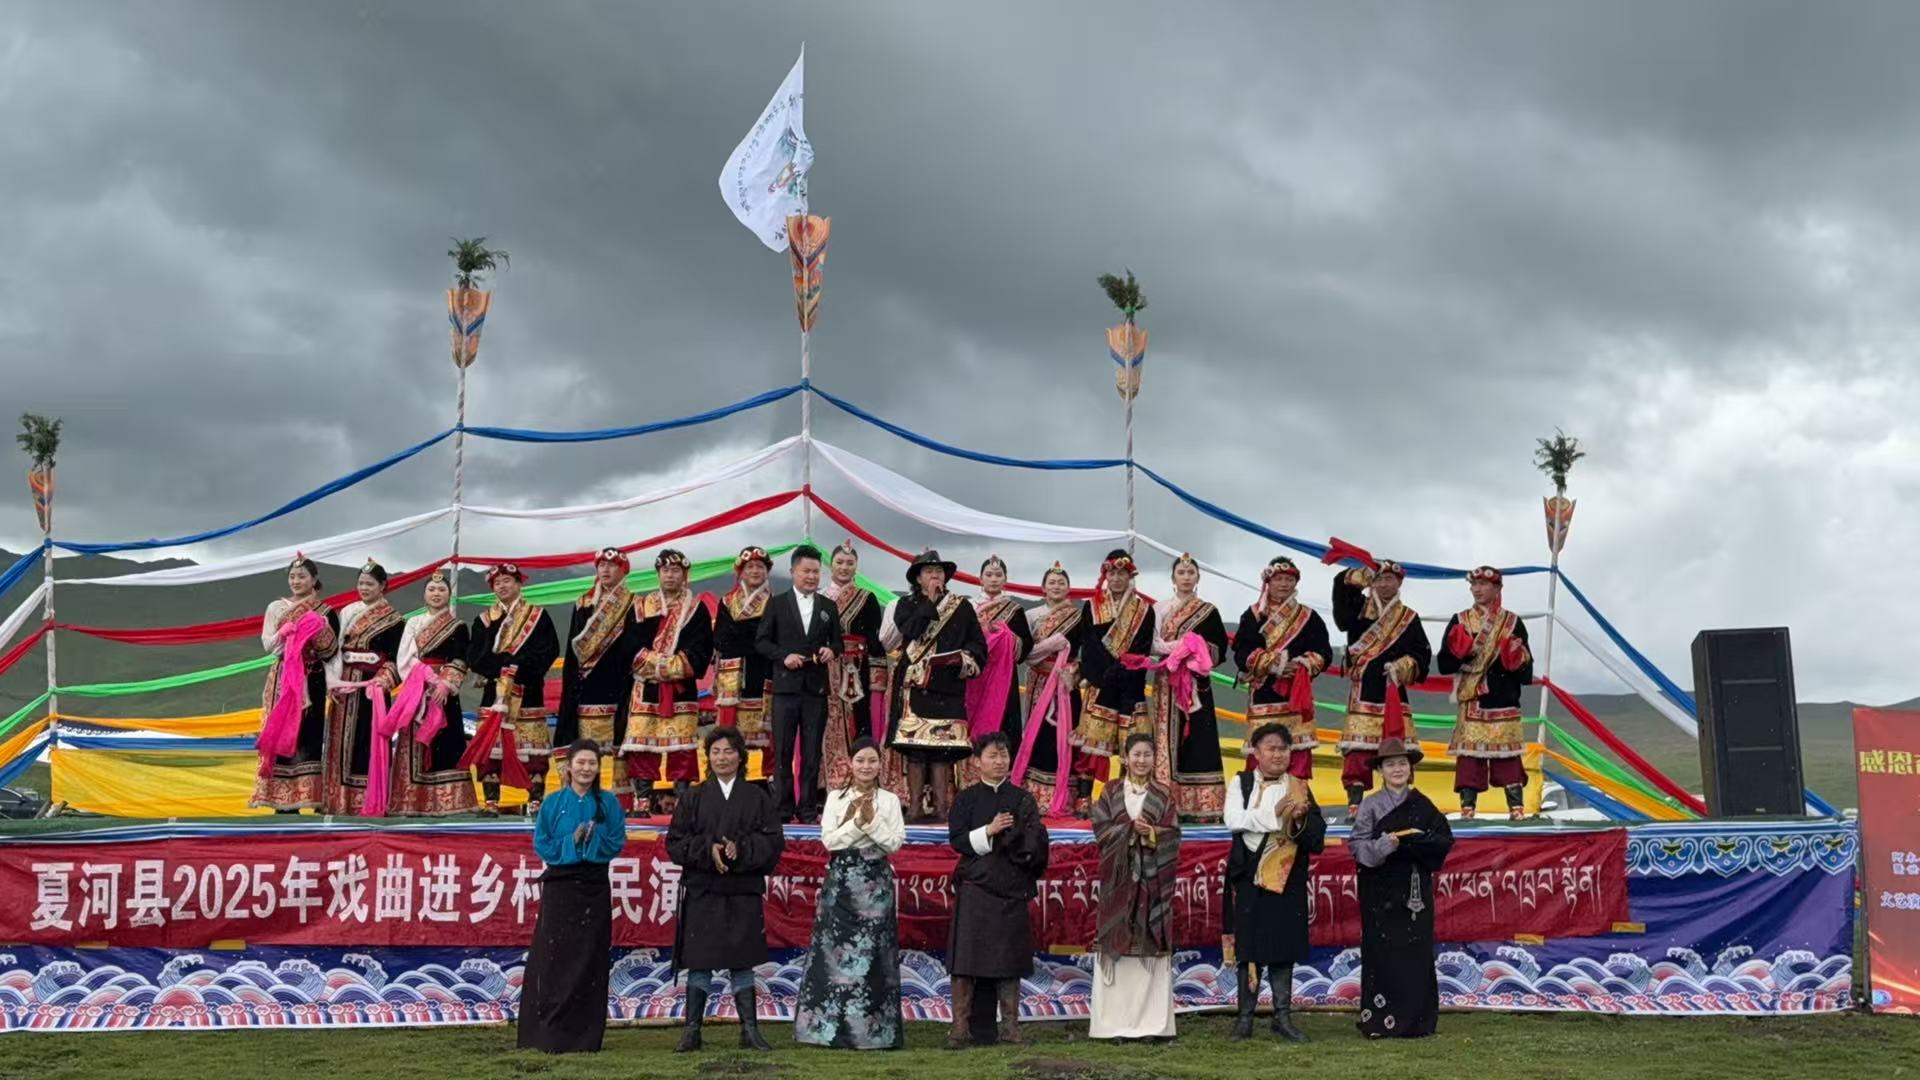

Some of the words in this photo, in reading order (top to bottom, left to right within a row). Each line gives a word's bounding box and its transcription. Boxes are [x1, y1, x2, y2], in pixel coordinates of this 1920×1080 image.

[29, 854, 683, 932] 夏河县2025年戏曲进乡村民演
